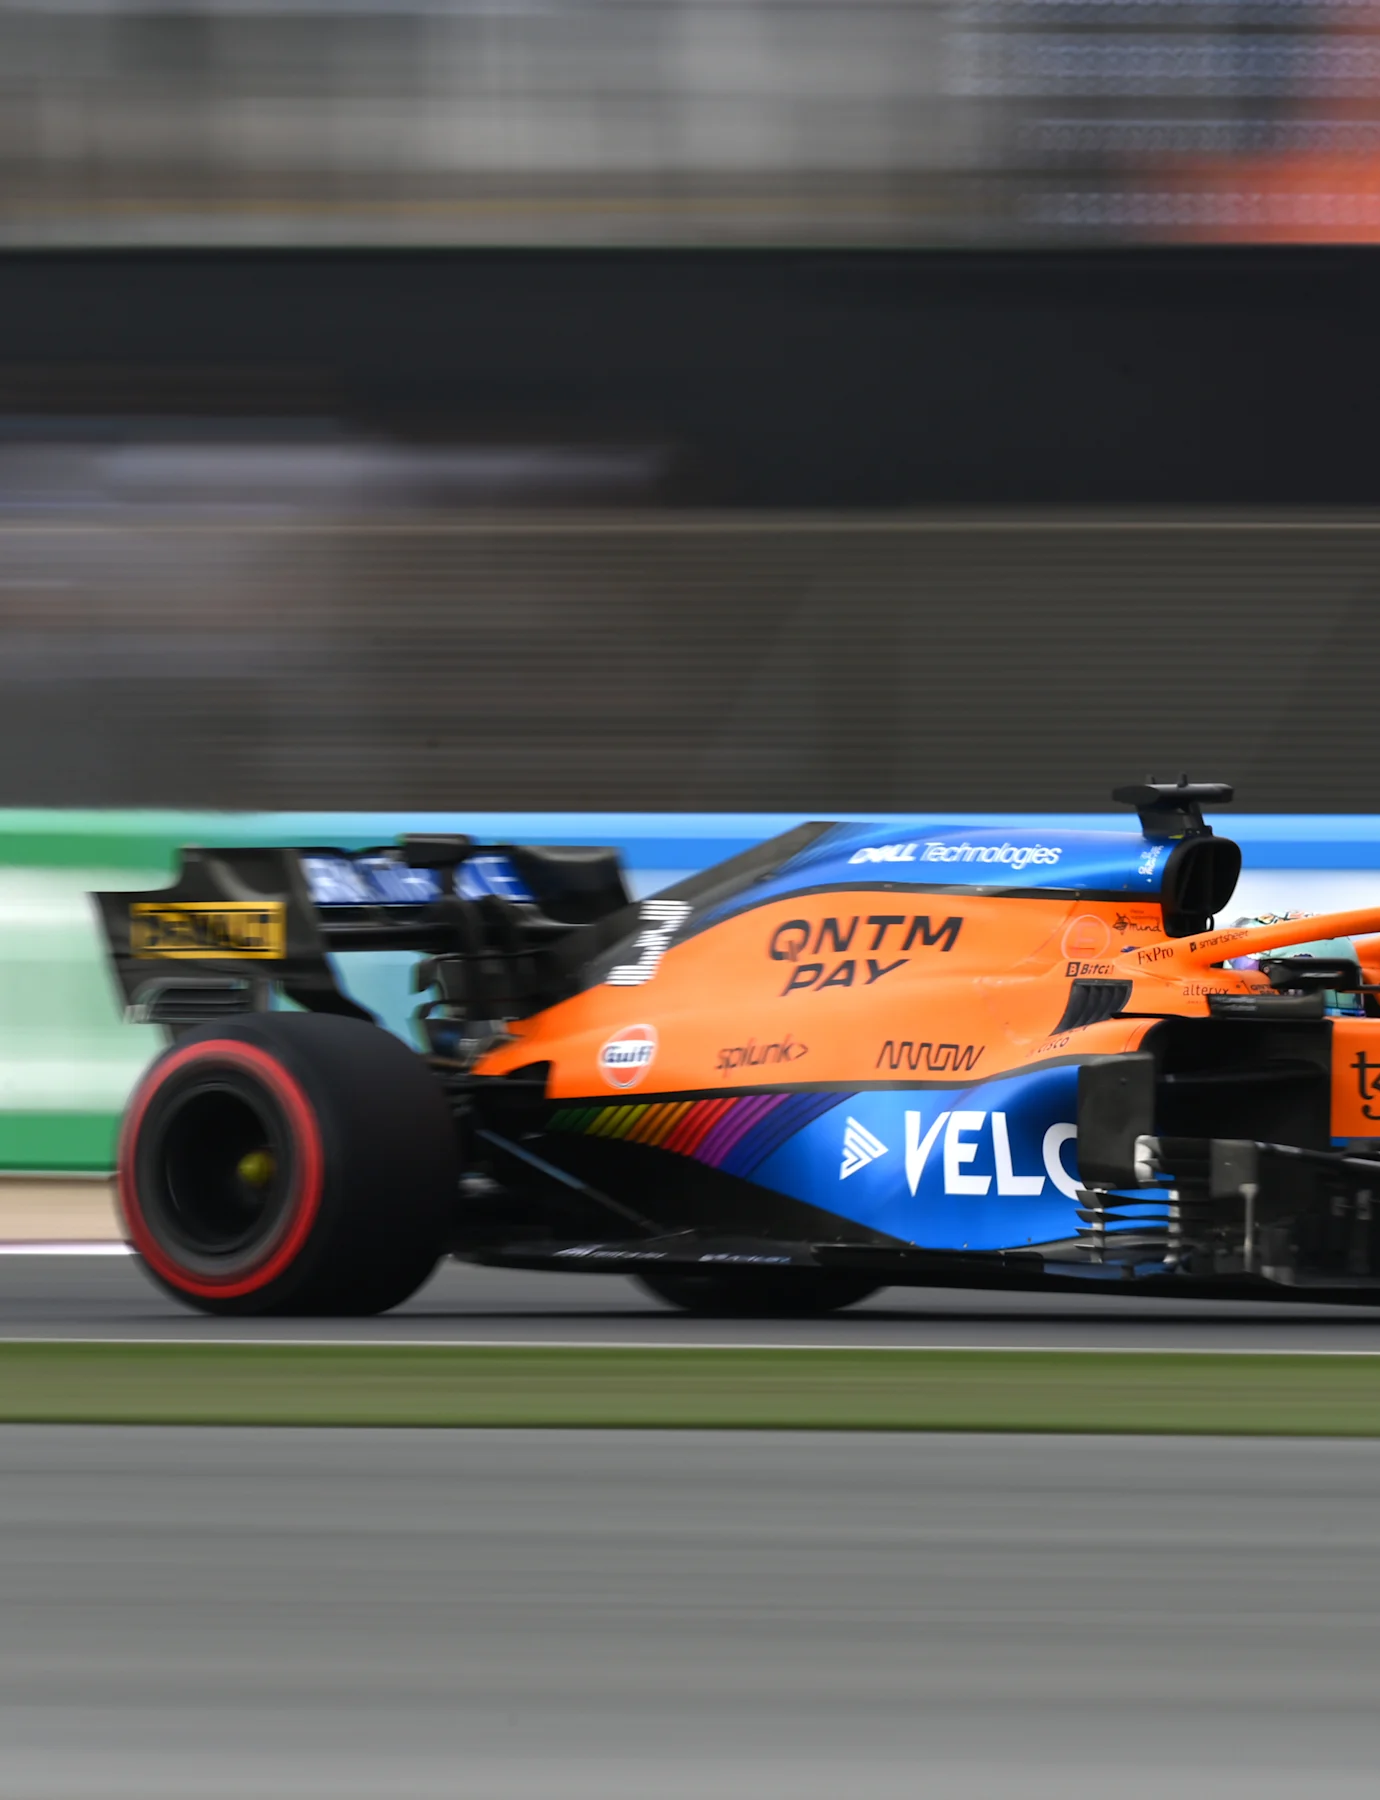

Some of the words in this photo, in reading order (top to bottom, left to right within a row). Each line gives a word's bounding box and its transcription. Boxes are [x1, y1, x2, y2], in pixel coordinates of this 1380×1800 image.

[848, 843, 919, 864] DELL
[920, 842, 1063, 870] Technologies
[769, 915, 964, 961] QNTM
[1199, 930, 1248, 949] smartsheet
[1137, 947, 1174, 965] FxPro
[780, 958, 910, 997] PAY
